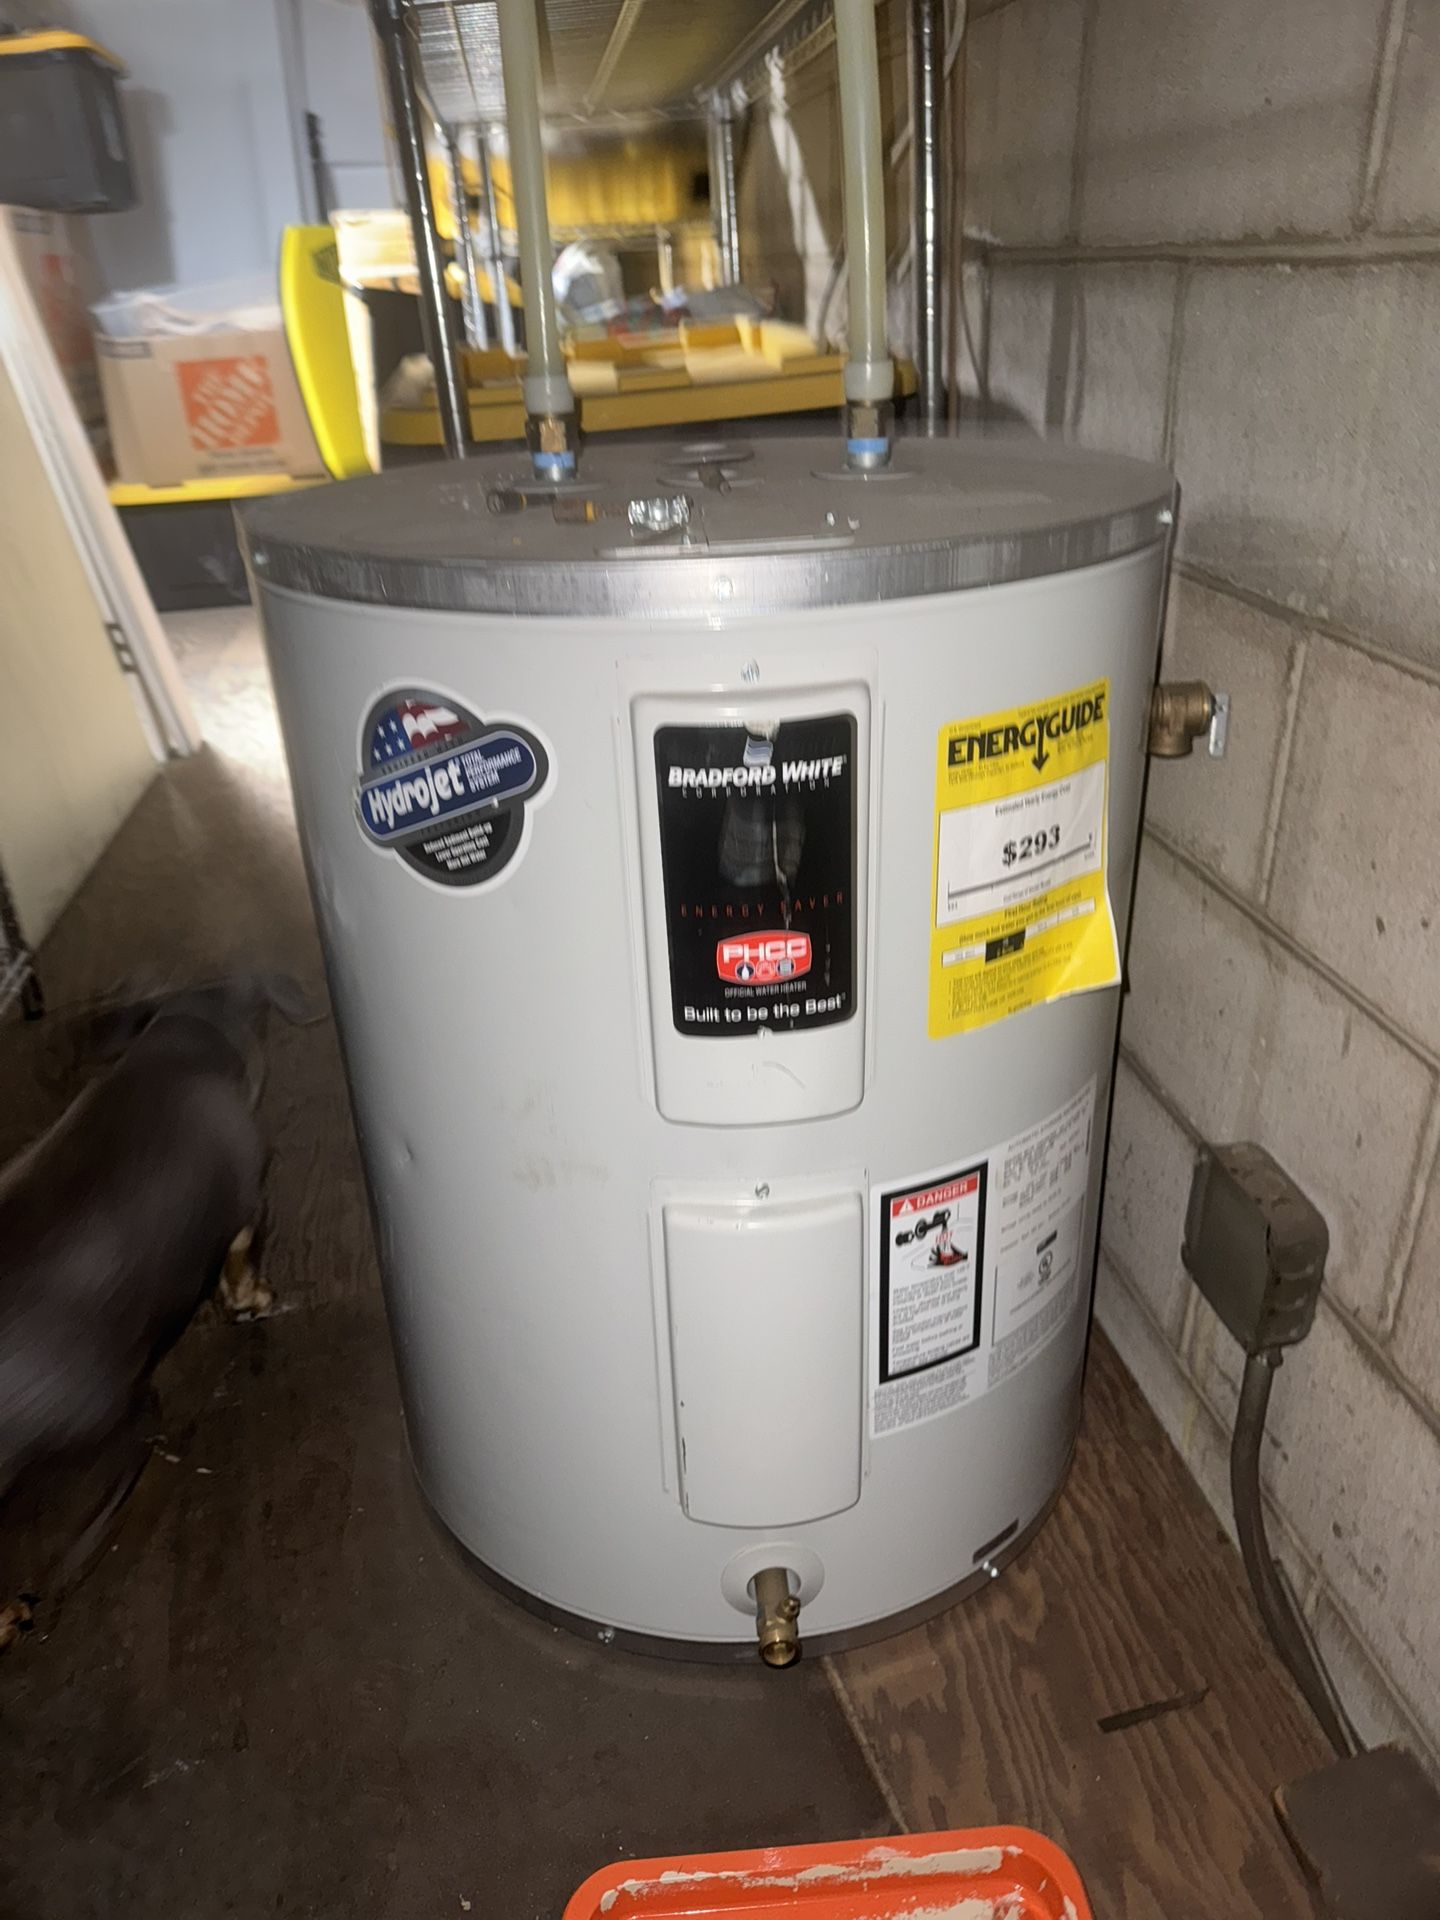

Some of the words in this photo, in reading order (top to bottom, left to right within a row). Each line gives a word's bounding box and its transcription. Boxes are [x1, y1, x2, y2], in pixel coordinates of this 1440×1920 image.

[192, 362, 263, 448] HOME
[460, 749, 484, 766] TOTAL
[465, 747, 523, 778] PERFORMANCE
[668, 765, 776, 787] BRADFORD
[781, 755, 845, 784] WHITE
[469, 772, 500, 793] SYSTEM
[682, 777, 831, 799] CORPORATION
[1002, 824, 1061, 868] $293
[681, 902, 764, 919] ENERGY
[722, 937, 807, 964] PHCC
[725, 986, 754, 998] OFFICIAL
[755, 983, 780, 996] WATER
[780, 980, 807, 994] HEATER
[684, 1005, 720, 1023] Built
[725, 1007, 742, 1023] to
[747, 1005, 768, 1022] be
[773, 1002, 800, 1019] the
[805, 994, 842, 1015] Best
[915, 1181, 968, 1209] DANGER
